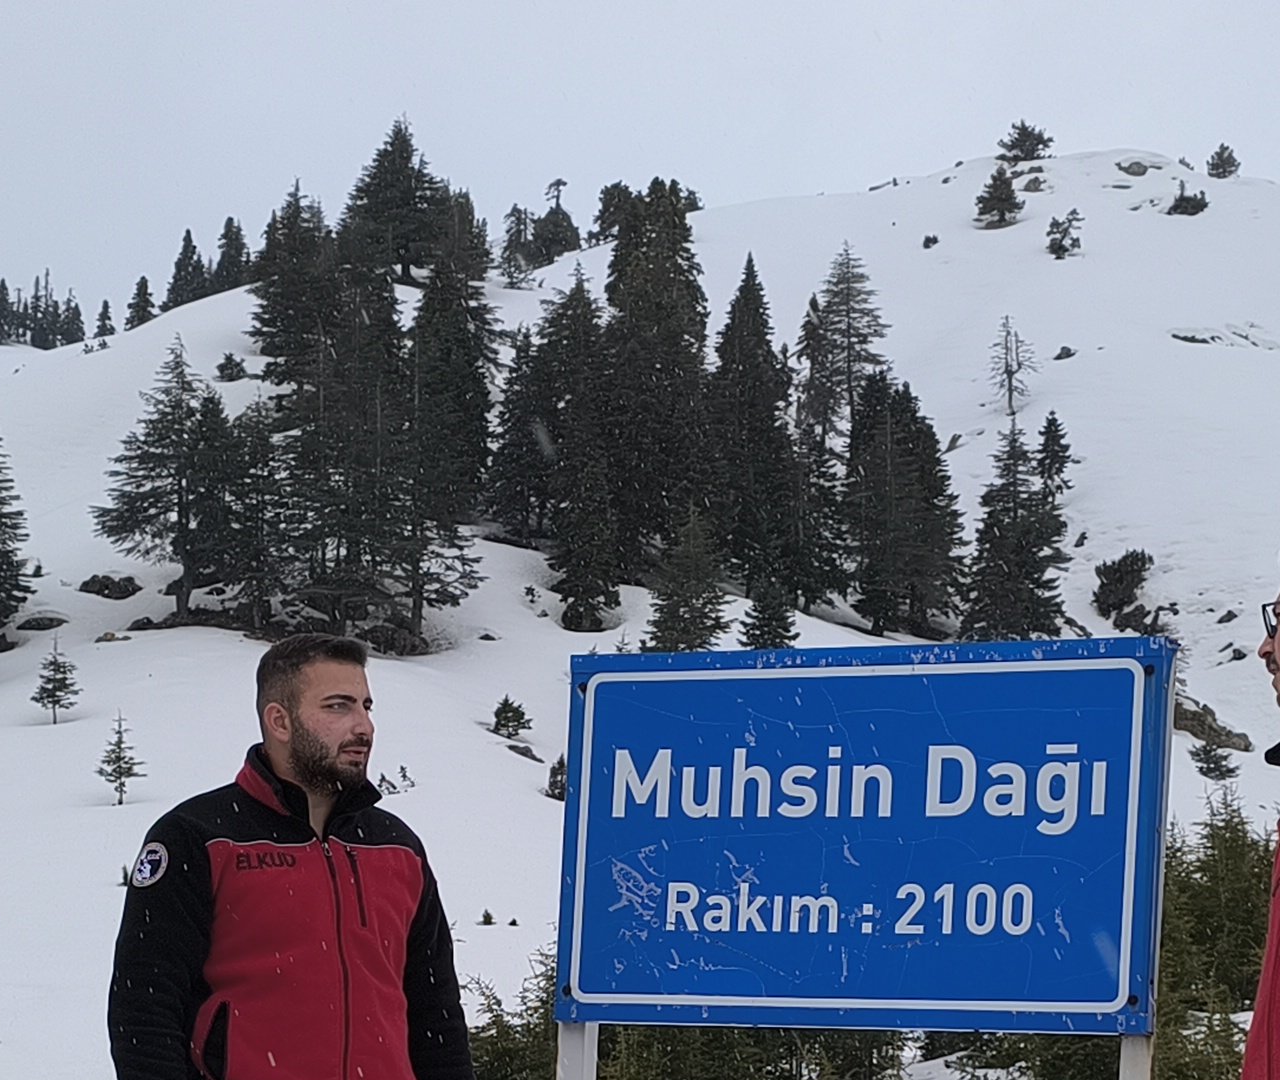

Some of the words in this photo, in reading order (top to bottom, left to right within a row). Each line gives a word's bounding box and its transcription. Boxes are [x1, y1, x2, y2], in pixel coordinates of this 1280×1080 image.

[611, 746, 894, 818] Muhsin
[925, 743, 1108, 836] Dağı
[665, 882, 838, 933] Rakım
[894, 883, 1034, 936] 2100
